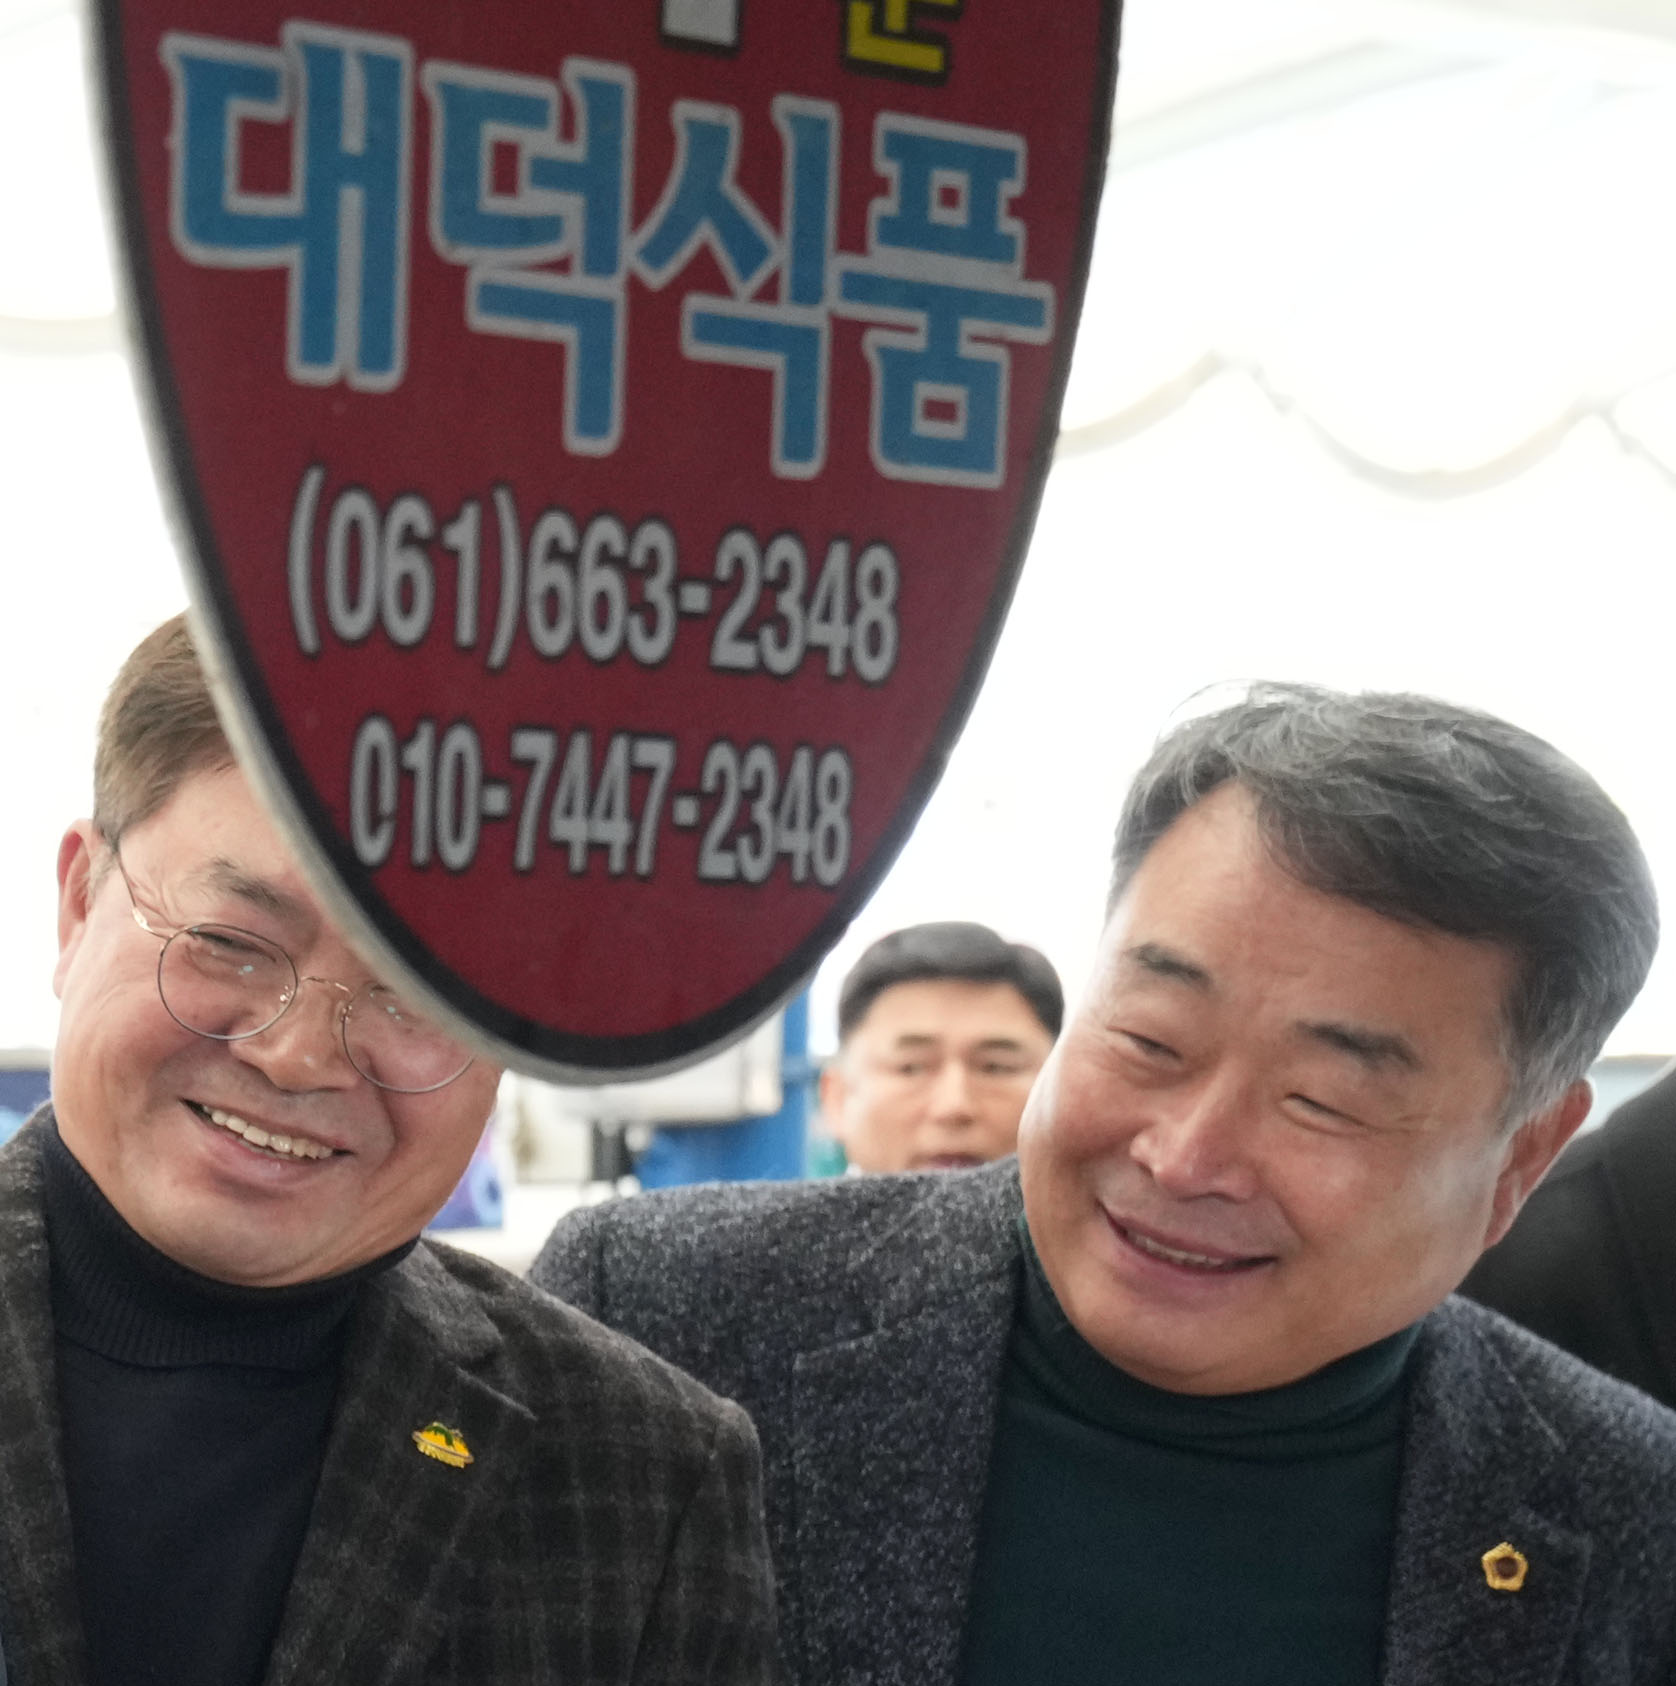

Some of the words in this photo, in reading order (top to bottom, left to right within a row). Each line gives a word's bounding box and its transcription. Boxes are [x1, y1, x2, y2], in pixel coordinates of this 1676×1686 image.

[160, 20, 1055, 490] 대덕식품
[288, 463, 901, 683] (061)663-2348
[351, 714, 853, 888] 010-7447-2348
